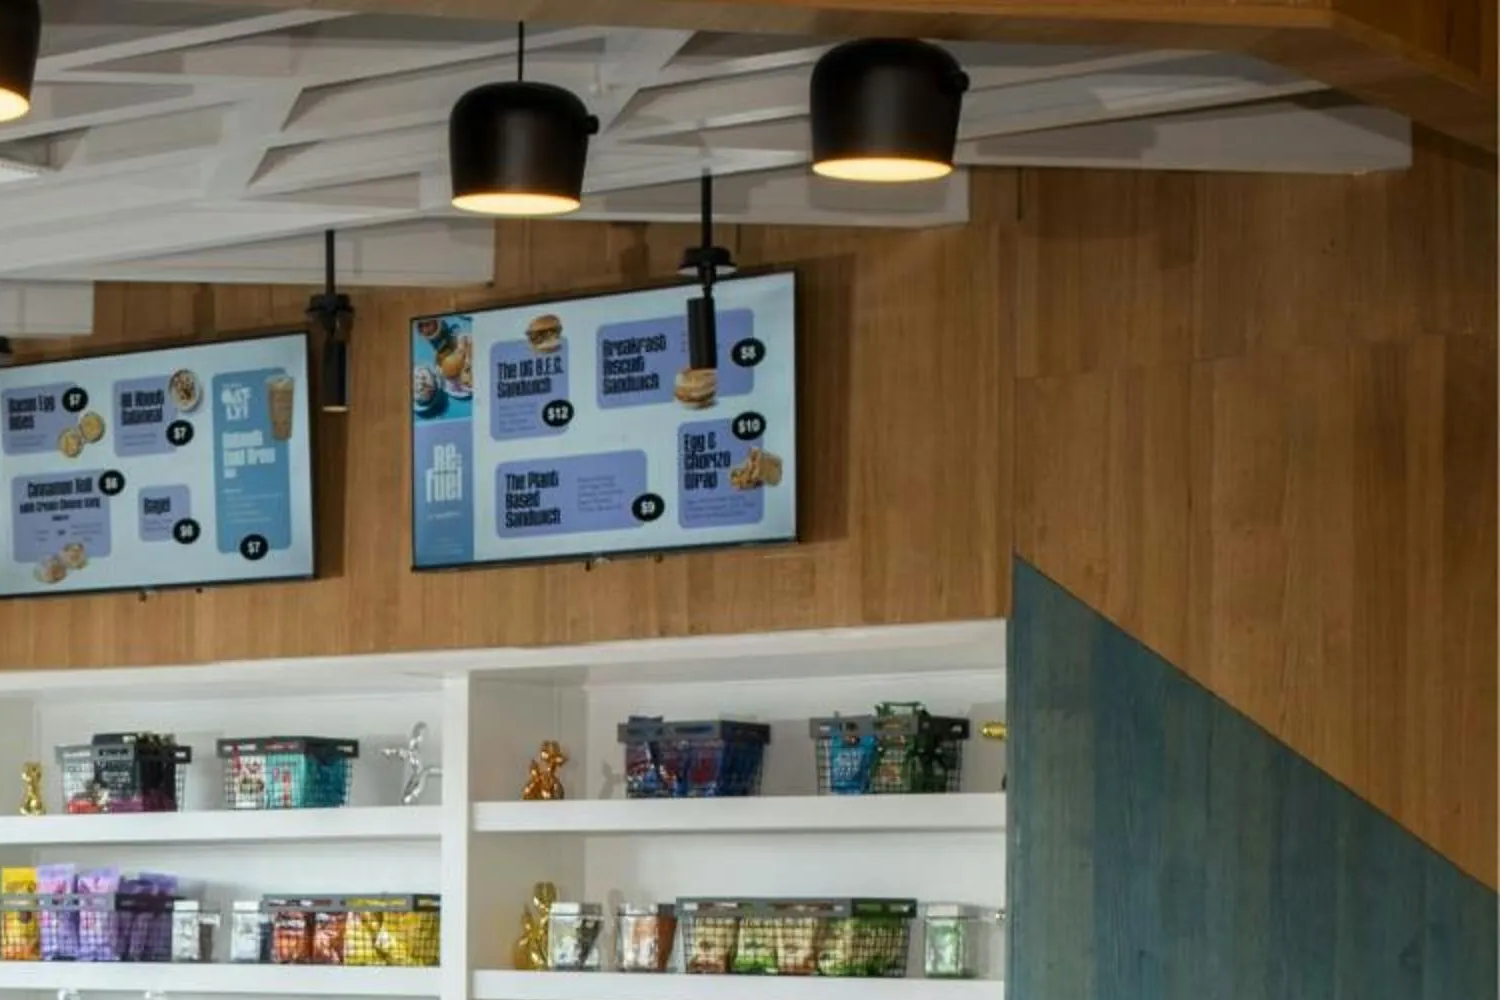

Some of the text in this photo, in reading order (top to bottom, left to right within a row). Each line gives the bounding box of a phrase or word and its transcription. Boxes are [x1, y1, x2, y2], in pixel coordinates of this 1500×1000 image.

[497, 361, 517, 380] The
[547, 405, 569, 421] $12
[737, 418, 761, 434] $10
[684, 432, 706, 452] Egg
[505, 473, 526, 491] The
